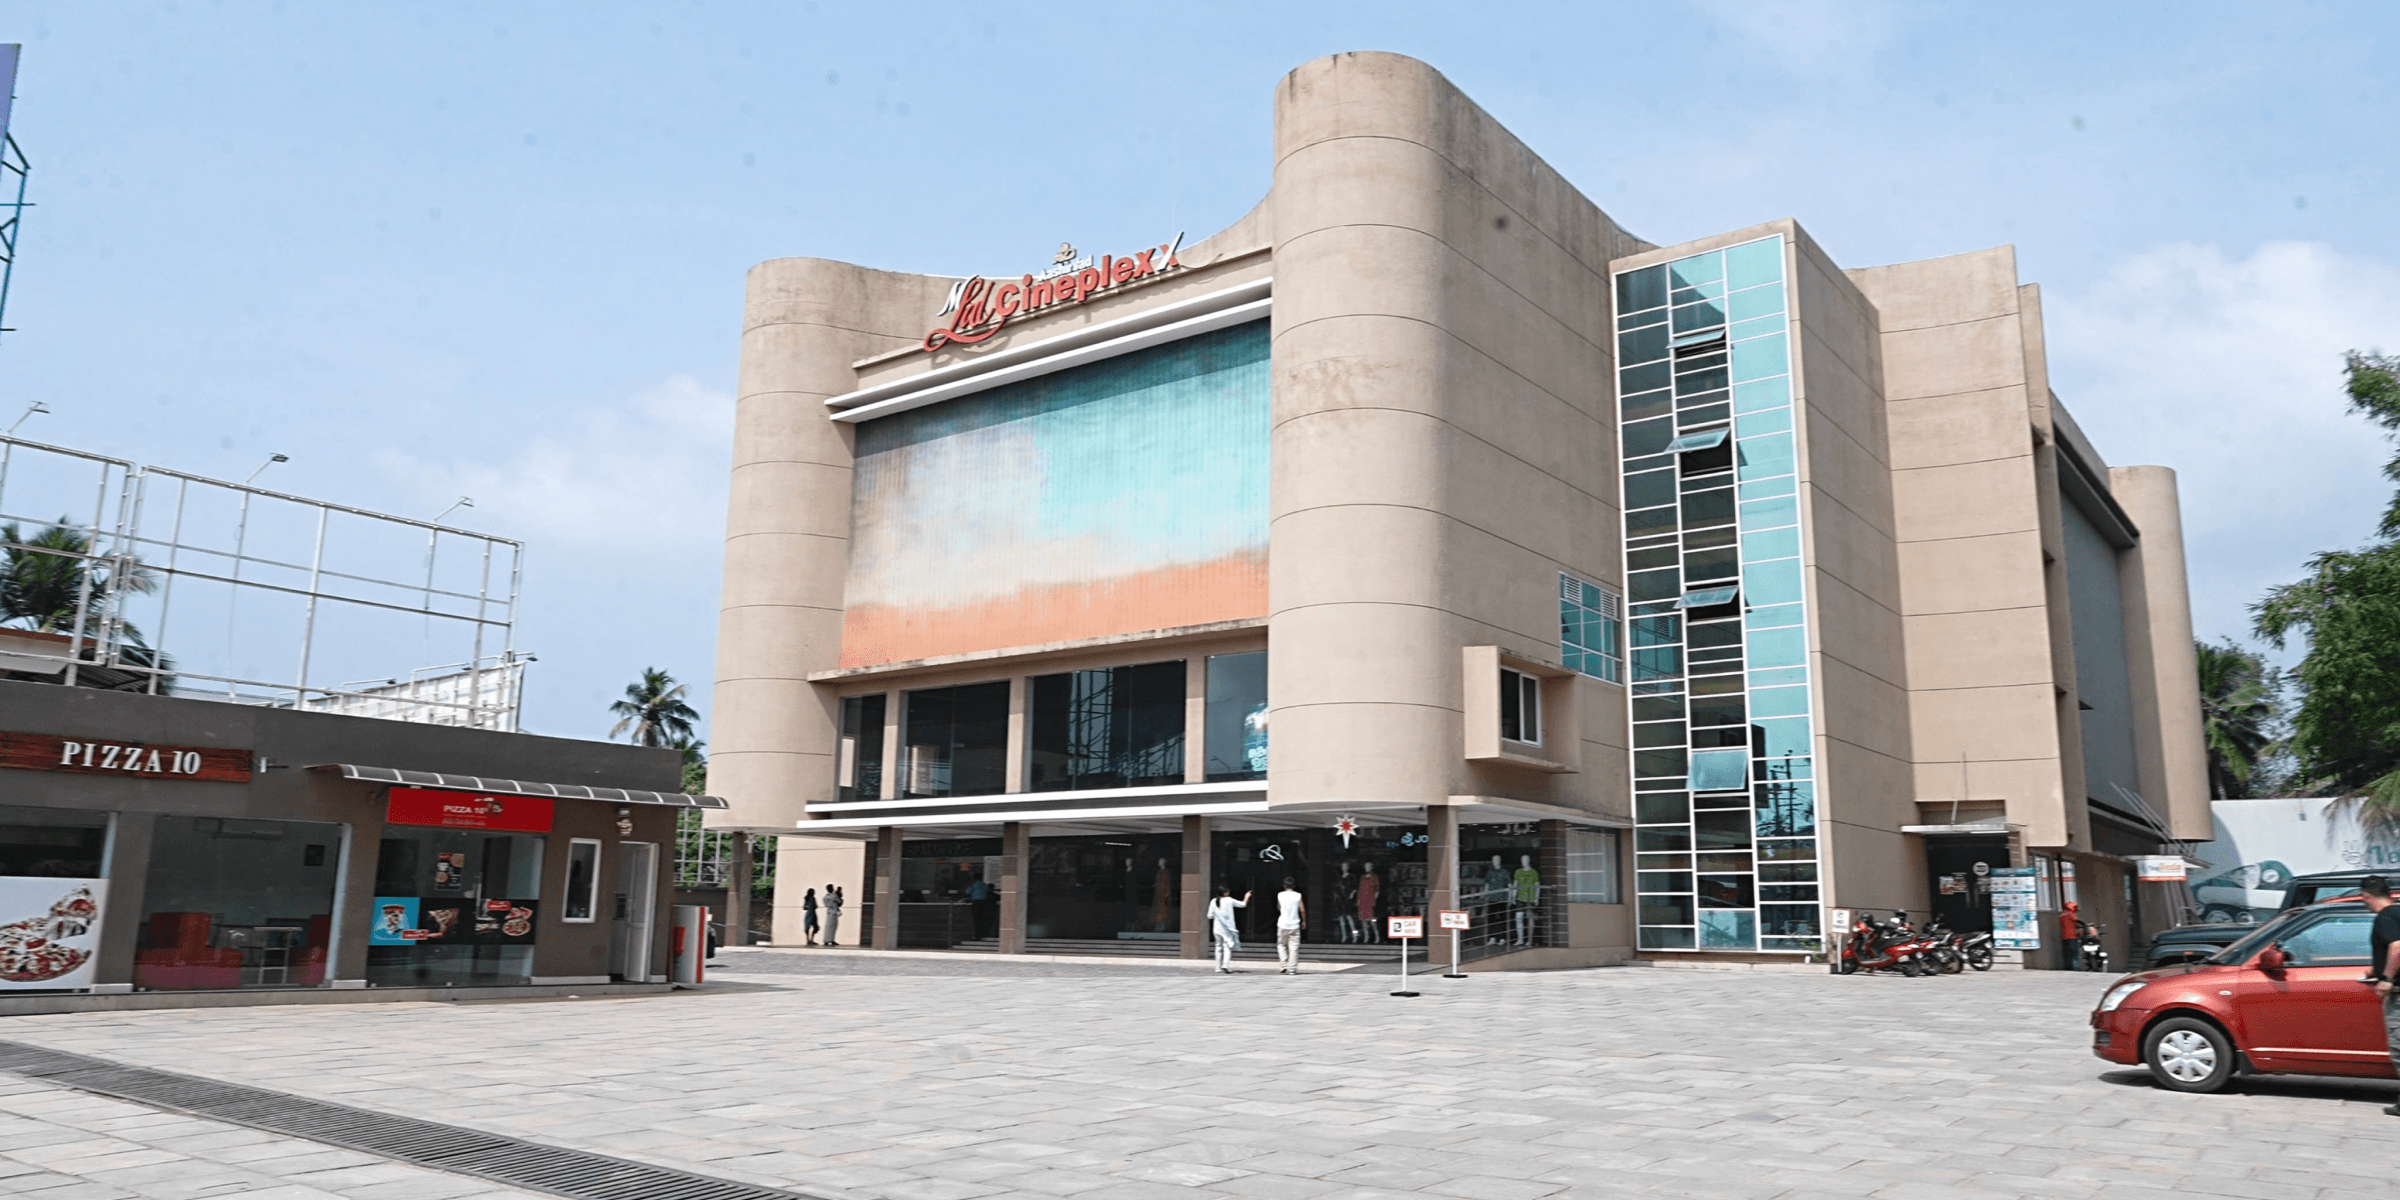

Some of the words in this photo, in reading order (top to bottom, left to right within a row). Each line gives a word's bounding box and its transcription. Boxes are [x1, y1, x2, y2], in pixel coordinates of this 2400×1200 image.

[60, 741, 162, 773] PIZZA
[170, 751, 201, 774] 10
[443, 804, 473, 815] PIZZA
